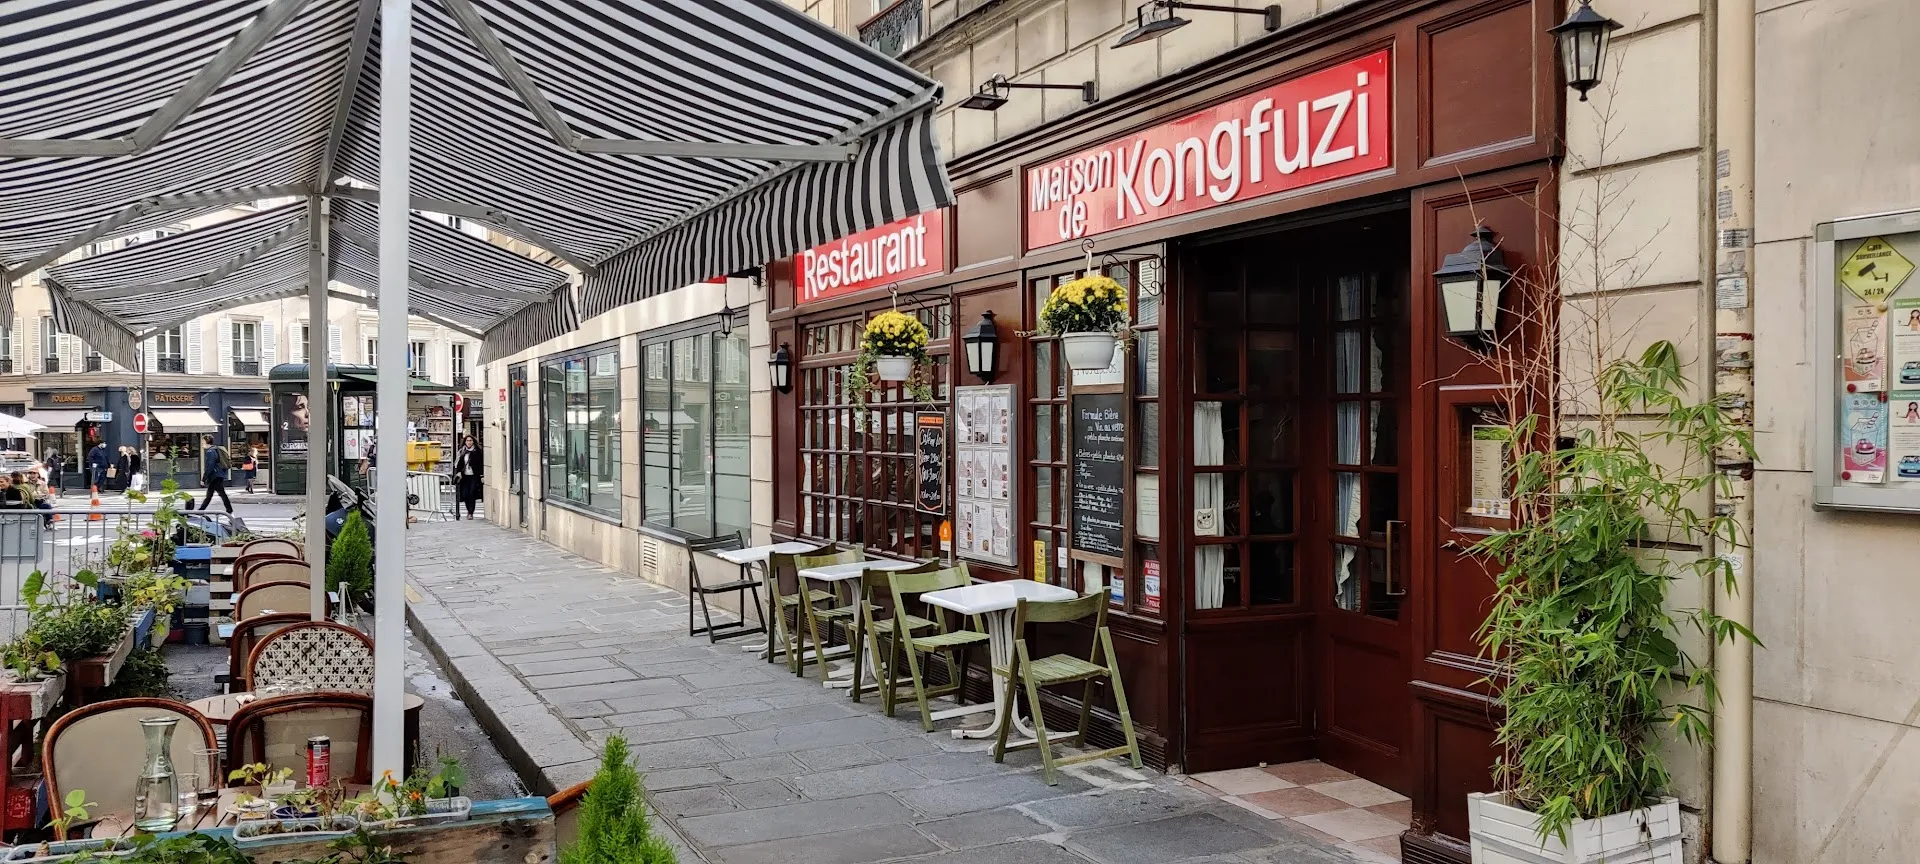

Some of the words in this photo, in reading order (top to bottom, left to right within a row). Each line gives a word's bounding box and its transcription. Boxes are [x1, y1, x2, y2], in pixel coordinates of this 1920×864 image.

[1032, 151, 1114, 212] Maison
[1117, 71, 1370, 220] Kongfuzi
[1059, 194, 1088, 239] de
[804, 214, 927, 300] Restaurant
[1856, 250, 1892, 260] SURVEILLANCE
[1864, 288, 1872, 296] 24
[1877, 287, 1884, 295] 24
[51, 394, 84, 403] BOULANGERIE
[155, 393, 195, 403] PÂTISSERIE
